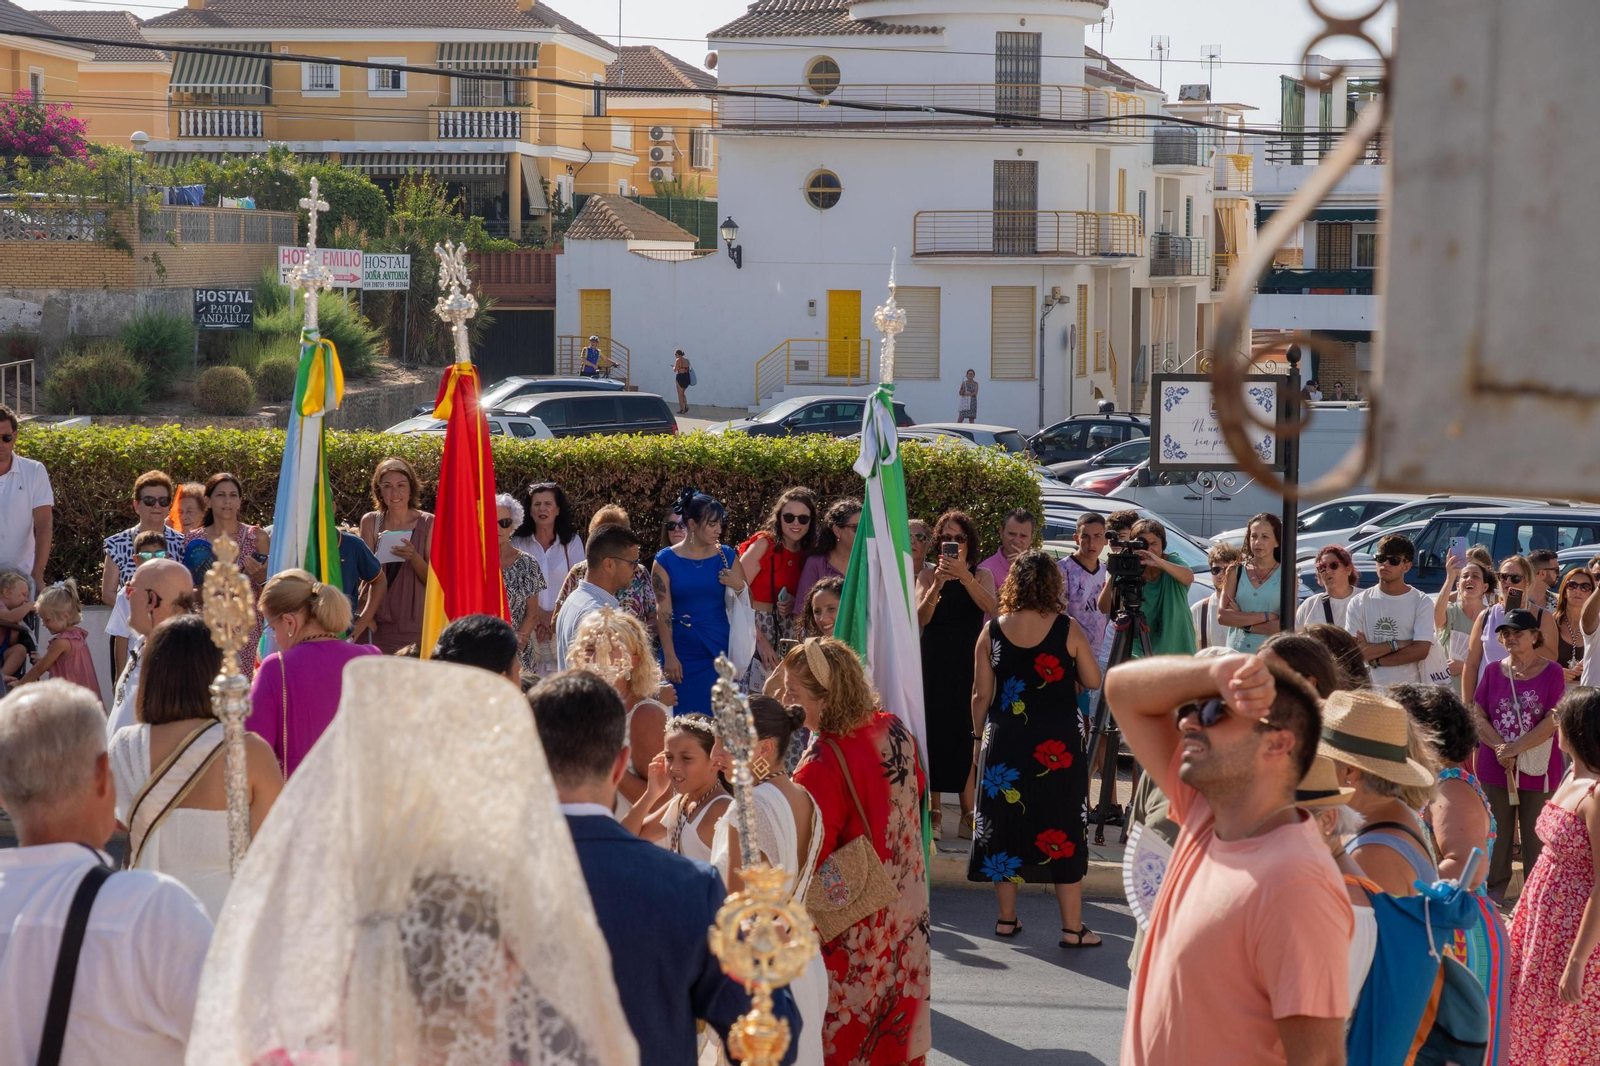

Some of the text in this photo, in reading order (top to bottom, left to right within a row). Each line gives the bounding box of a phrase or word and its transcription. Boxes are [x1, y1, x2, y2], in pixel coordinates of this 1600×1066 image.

[322, 250, 361, 267] EMILIO
[365, 256, 408, 268] HOSTAL
[365, 270, 380, 280] DOÑA
[382, 271, 408, 280] ANTONIA
[196, 290, 253, 303] HOSTAL
[210, 304, 242, 314] PATIO
[199, 313, 251, 323] ANDALUZ
[1192, 418, 1204, 433] Ni
[1194, 438, 1209, 446] sin
